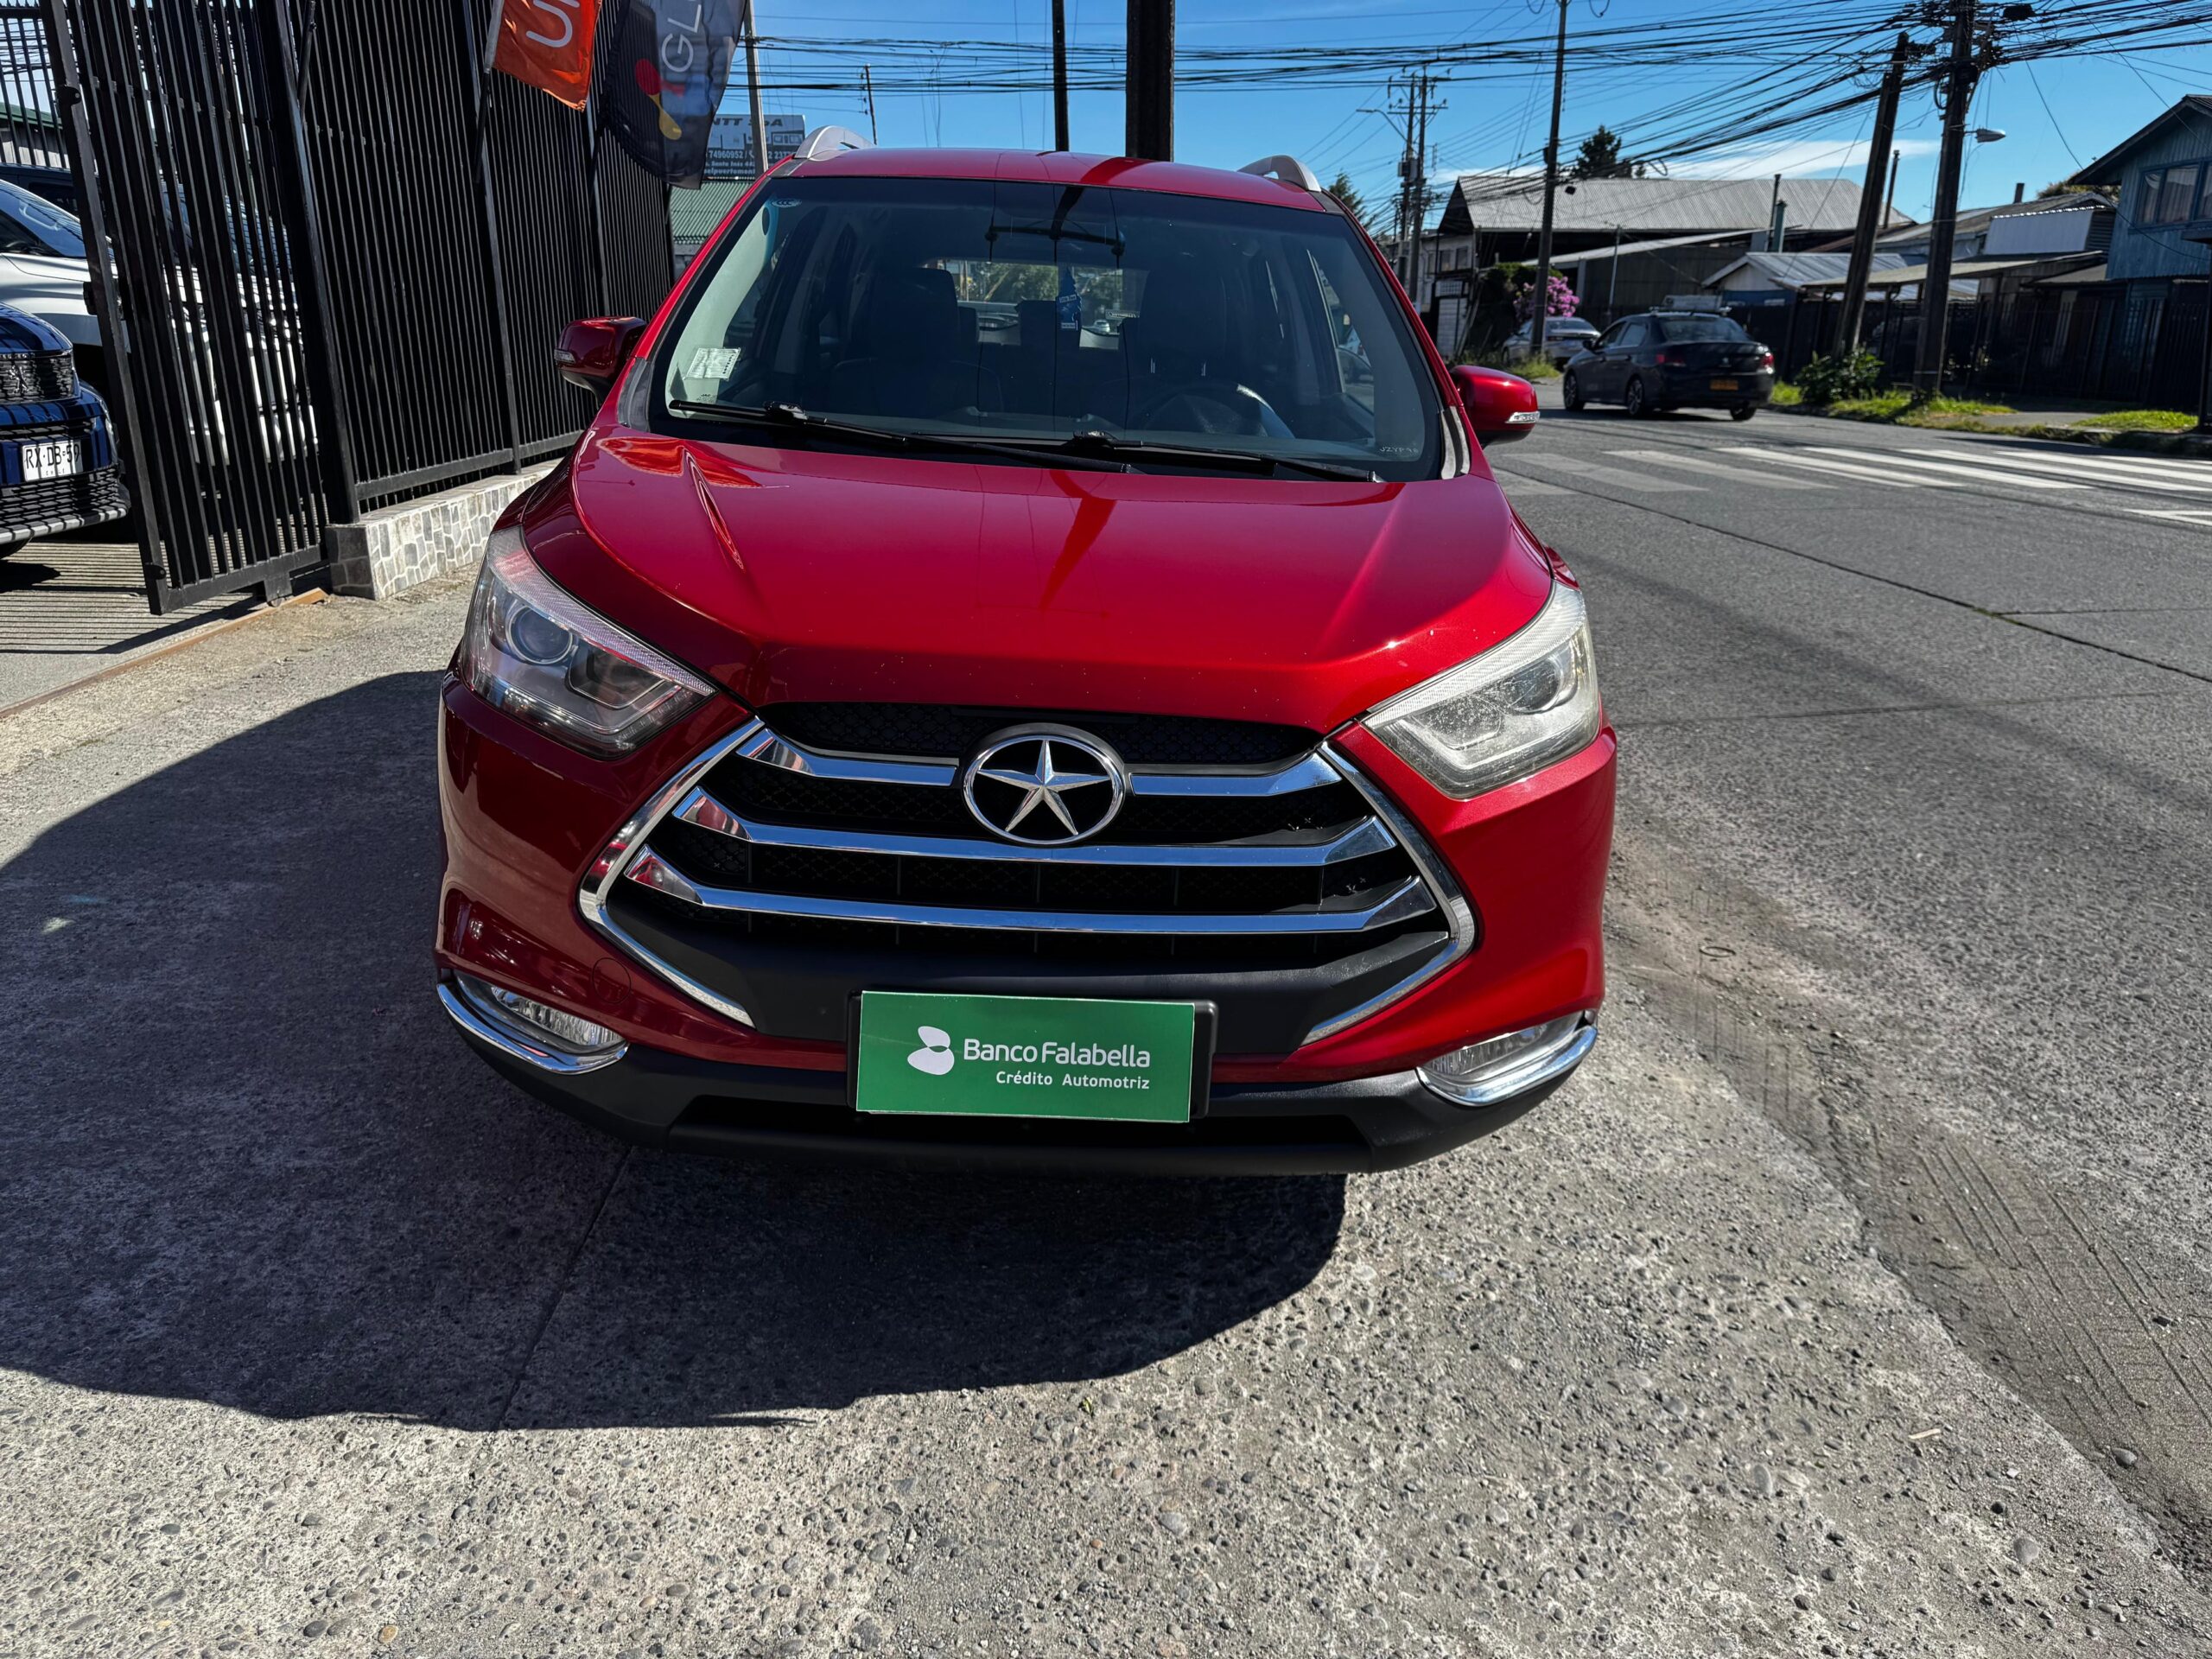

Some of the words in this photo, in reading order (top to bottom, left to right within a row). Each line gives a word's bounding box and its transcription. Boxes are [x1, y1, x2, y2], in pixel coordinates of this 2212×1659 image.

[963, 1039, 1037, 1062] Banco
[1041, 1042, 1151, 1067] Falabella
[996, 1071, 1052, 1085] Crédito
[1062, 1074, 1150, 1089] Automotriz
